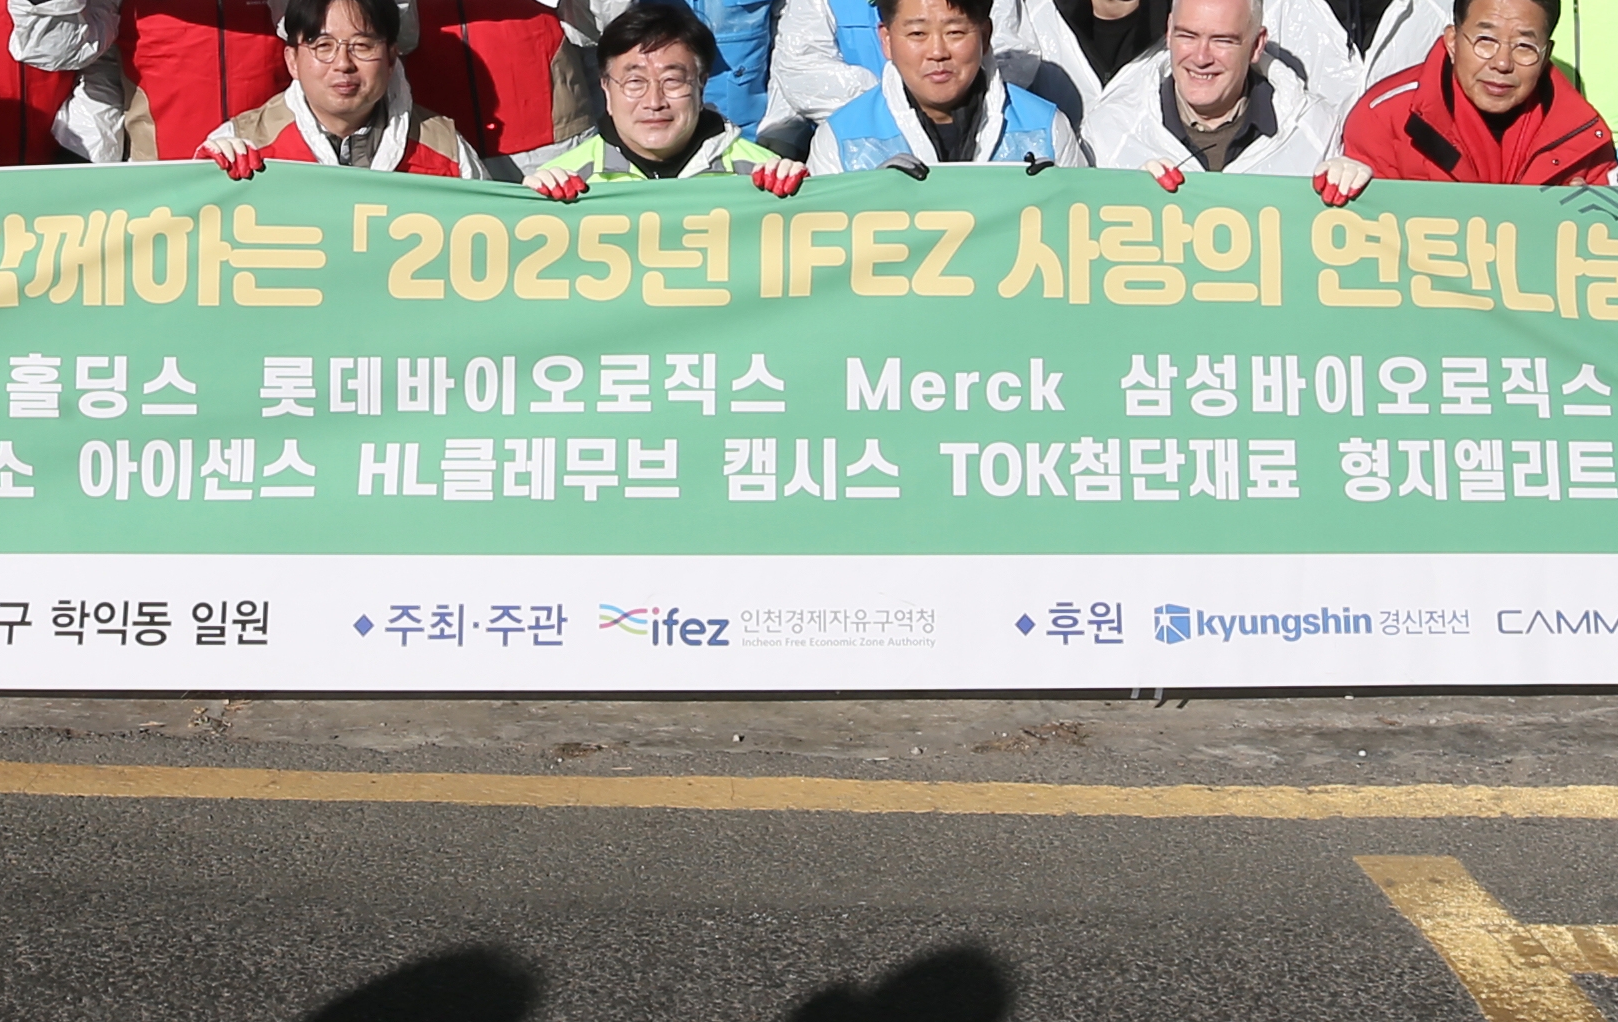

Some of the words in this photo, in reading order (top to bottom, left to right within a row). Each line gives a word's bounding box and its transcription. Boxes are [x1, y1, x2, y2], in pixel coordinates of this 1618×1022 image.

[354, 205, 730, 306] 「2025년
[762, 212, 974, 297] IFEZ
[999, 204, 1281, 305] 사랑의
[260, 354, 785, 417] 롯데바이오로직스
[847, 358, 1065, 411] Merck
[1121, 355, 1611, 418] 삼성바이오로직스
[79, 439, 315, 500] 아이센스
[358, 438, 679, 501] HL클레무브
[724, 438, 900, 500] 캠시스
[940, 437, 1299, 500] TOK첨단재료
[1339, 438, 1618, 501] 형지엘리트
[52, 600, 171, 646] 학익동
[192, 600, 268, 645] 일원
[385, 604, 567, 646] 주최·주관
[653, 608, 729, 646] ifez
[741, 609, 934, 634] 인천경제자유구역청
[1047, 602, 1123, 645] 후원
[1197, 607, 1372, 642] kyungshin
[1380, 610, 1470, 635] 경신전선
[742, 637, 782, 647] Incheon
[785, 637, 807, 647] Free
[809, 637, 857, 647] Economic
[859, 637, 884, 647] Zone
[887, 637, 936, 649] Authority
